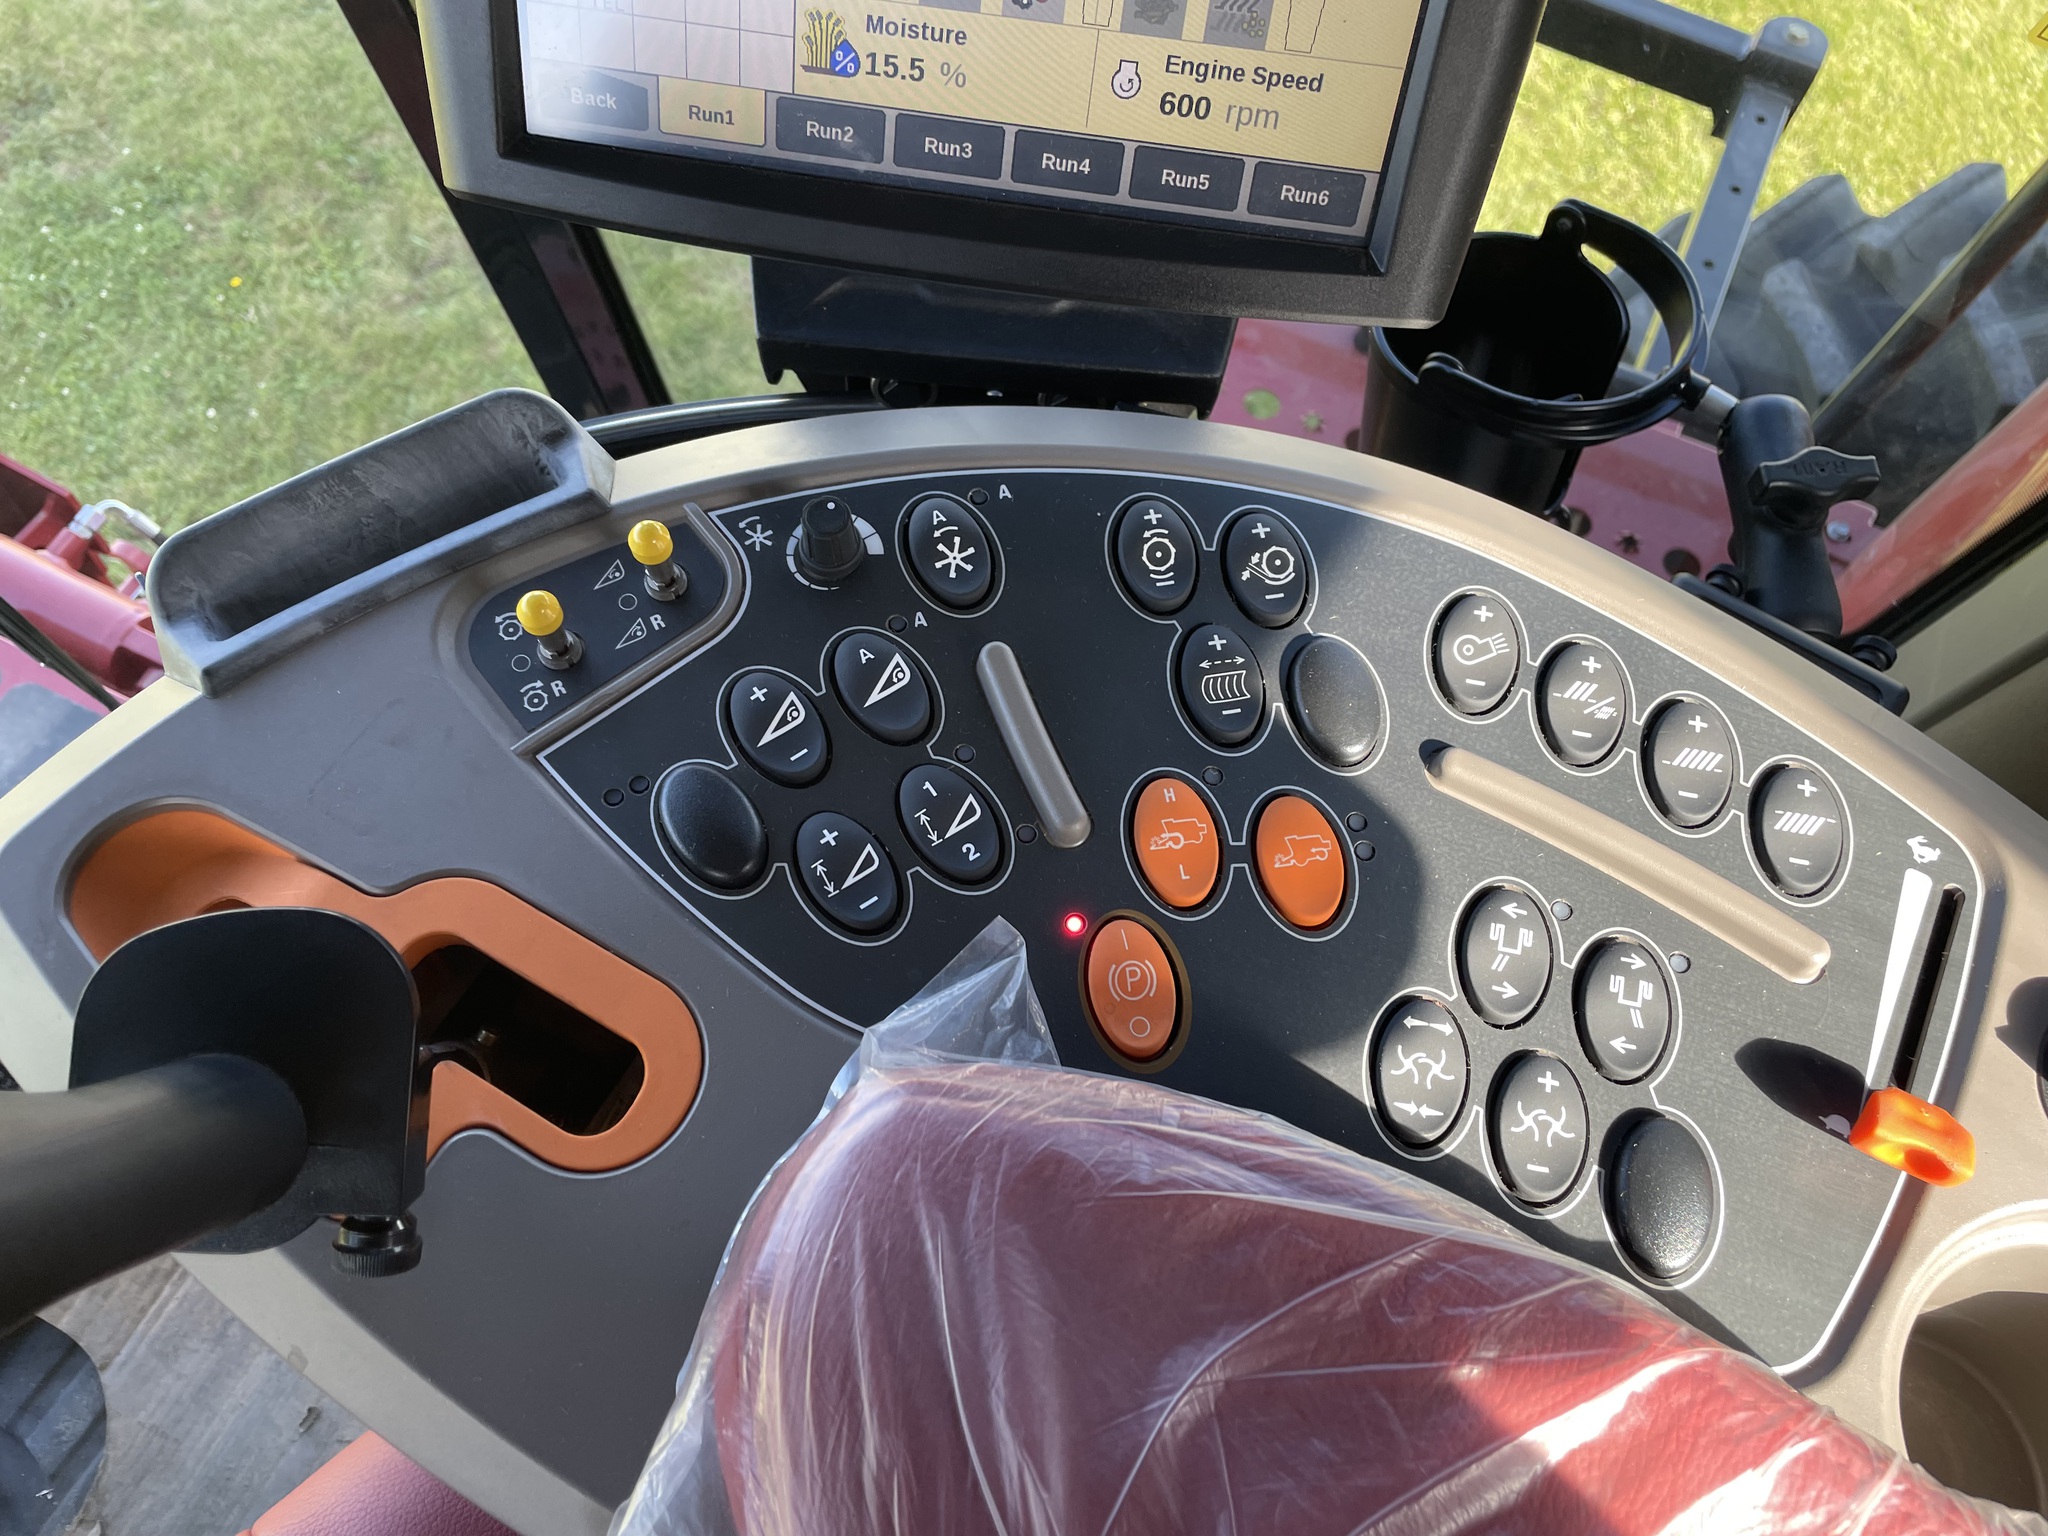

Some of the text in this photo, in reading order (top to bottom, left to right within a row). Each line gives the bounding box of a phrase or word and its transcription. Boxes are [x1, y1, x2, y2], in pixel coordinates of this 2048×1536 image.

[864, 14, 968, 46] Moisture
[864, 51, 967, 89] 15.5 %
[1164, 54, 1324, 94] Engine Speed
[570, 87, 617, 111] Back
[688, 104, 735, 126] Run1
[1158, 91, 1280, 131] 600 rpm
[806, 121, 854, 143] Run2
[924, 136, 973, 159] Run3
[1041, 152, 1091, 175] Run4
[1161, 168, 1210, 191] Run5
[1280, 184, 1330, 207] Run6
[998, 484, 1013, 501] A
[931, 509, 946, 526] A
[649, 613, 666, 632] R
[913, 611, 928, 628] A
[858, 648, 874, 664] A
[550, 680, 567, 698] R
[922, 780, 938, 798] 1
[1163, 788, 1176, 803] H
[962, 842, 981, 862] 2
[1180, 863, 1191, 880] L
[1125, 966, 1142, 992] P
